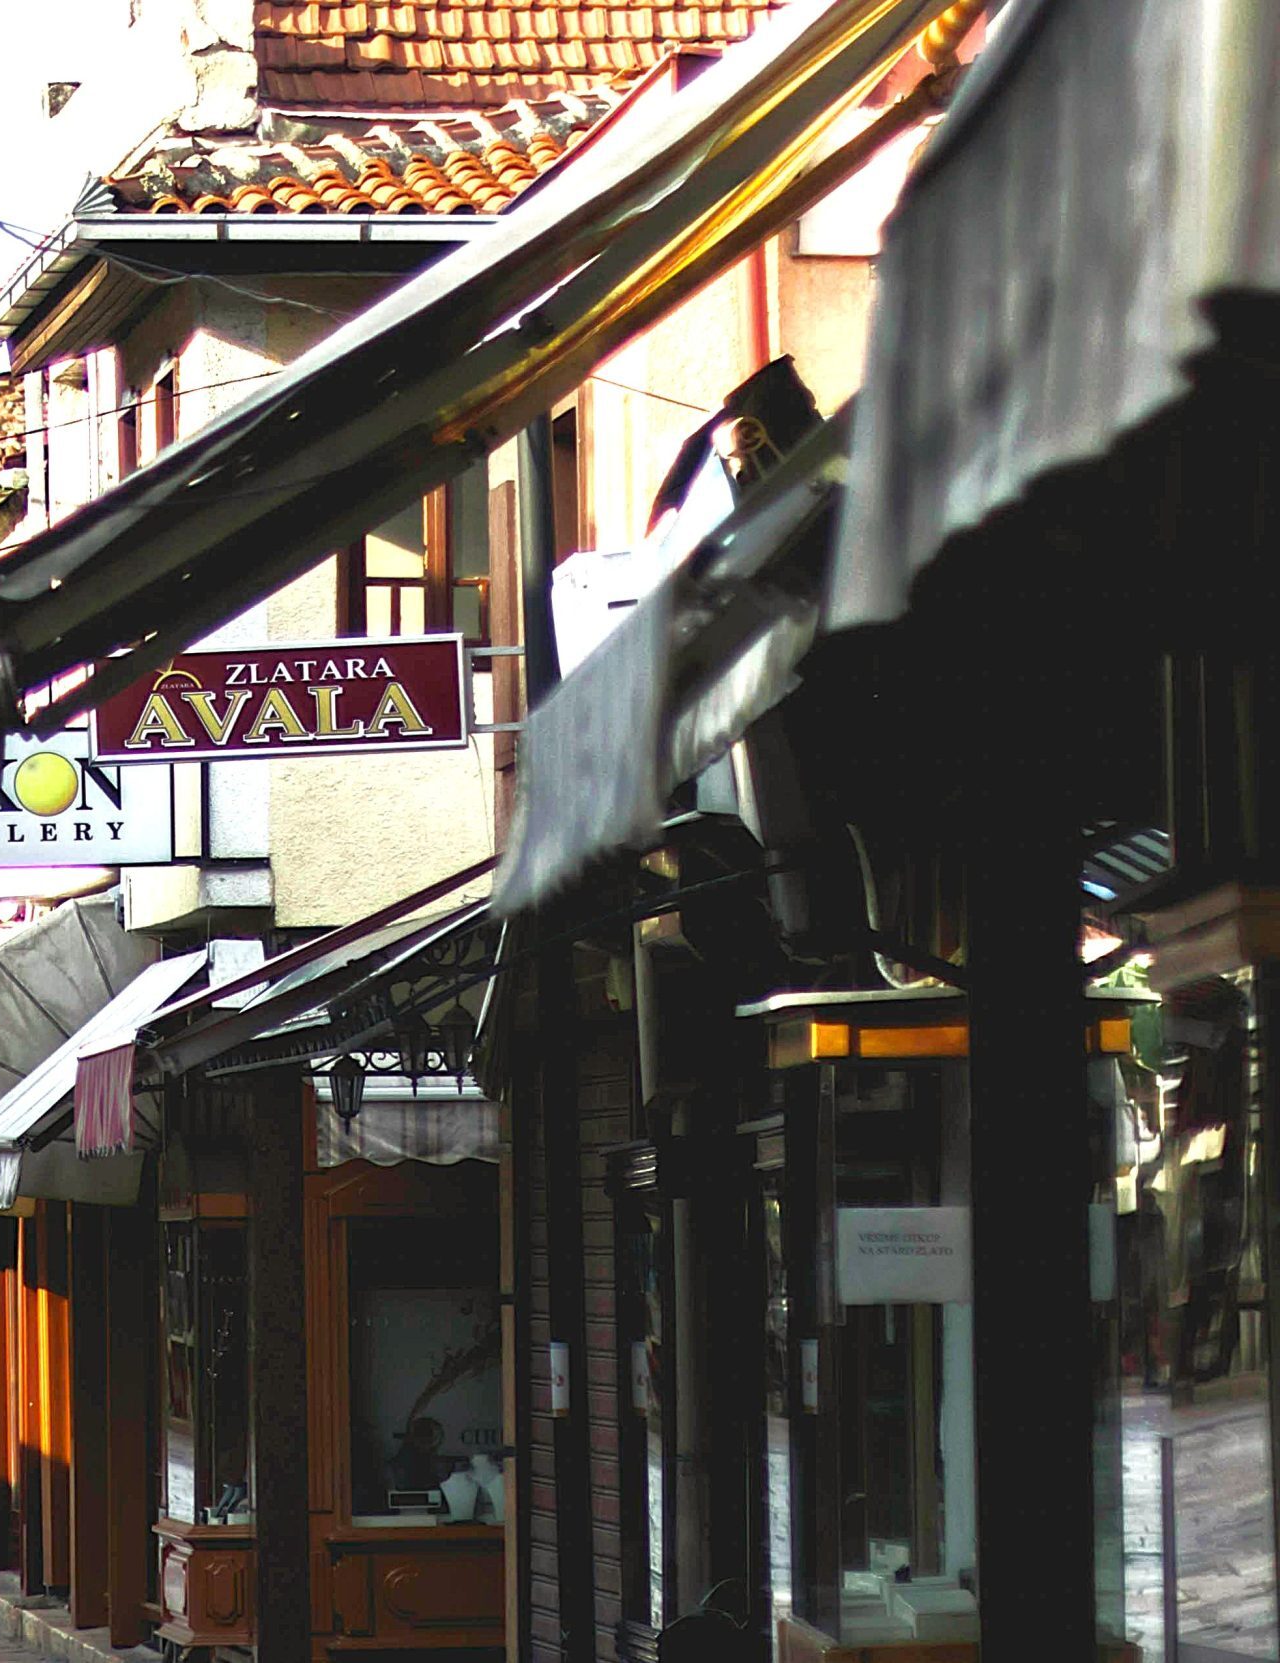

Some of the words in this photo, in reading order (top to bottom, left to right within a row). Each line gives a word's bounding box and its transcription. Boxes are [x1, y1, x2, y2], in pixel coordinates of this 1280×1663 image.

[225, 657, 394, 685] ZLATARA
[160, 682, 195, 690] ZLATARA
[124, 681, 433, 748] AVALA
